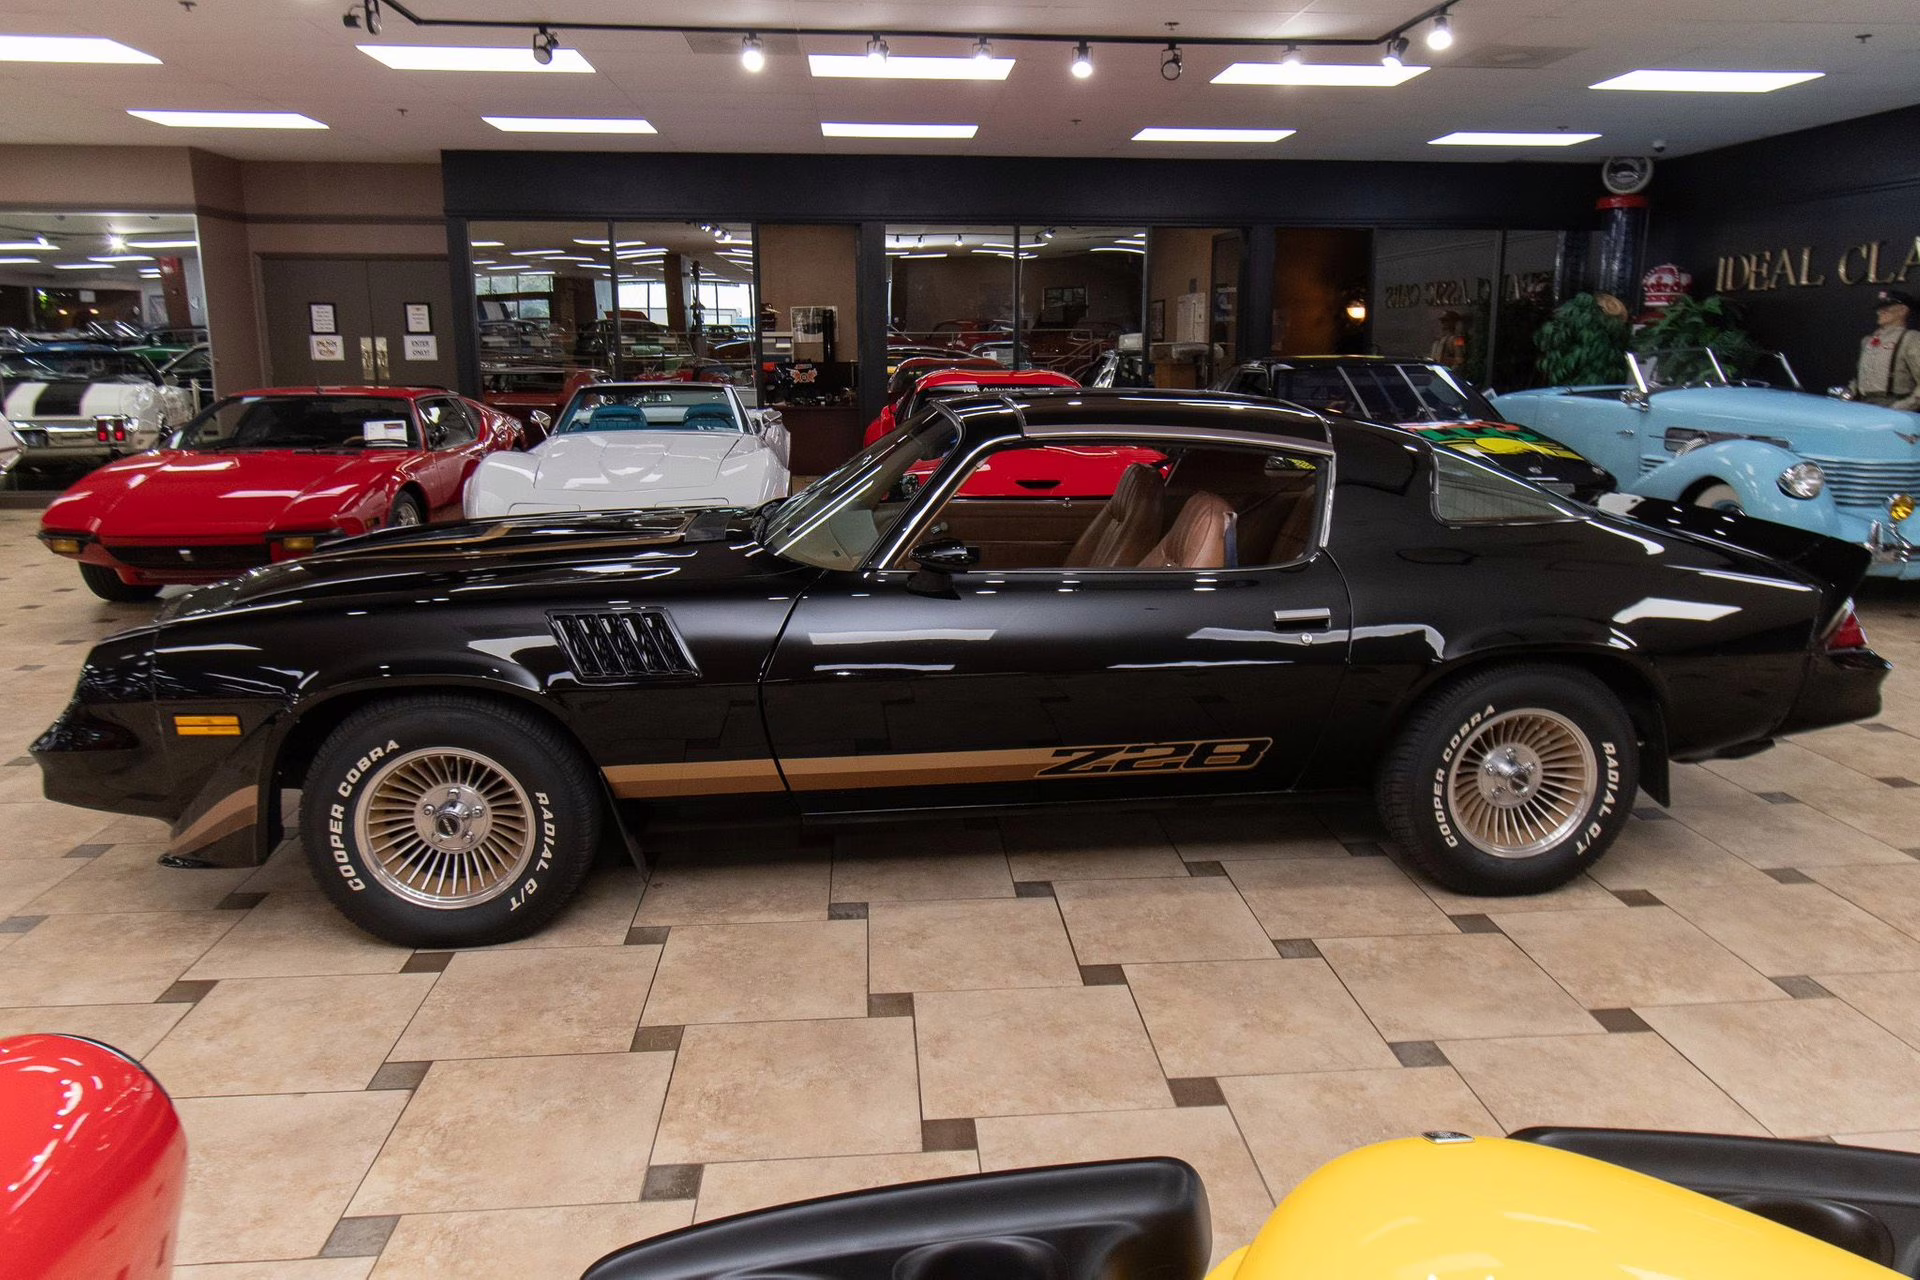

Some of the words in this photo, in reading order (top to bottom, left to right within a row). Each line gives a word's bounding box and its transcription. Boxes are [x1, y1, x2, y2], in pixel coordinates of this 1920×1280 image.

[1715, 247, 1825, 292] IDEAL
[1034, 736, 1273, 777] Z28
[1443, 704, 1495, 762] COBRA
[338, 739, 399, 798] COBRA
[1598, 741, 1620, 817] RADIAL
[535, 791, 556, 872] RADIAL
[1433, 768, 1458, 849] COOPER
[329, 803, 366, 892] COOPER
[510, 877, 538, 911] G/T
